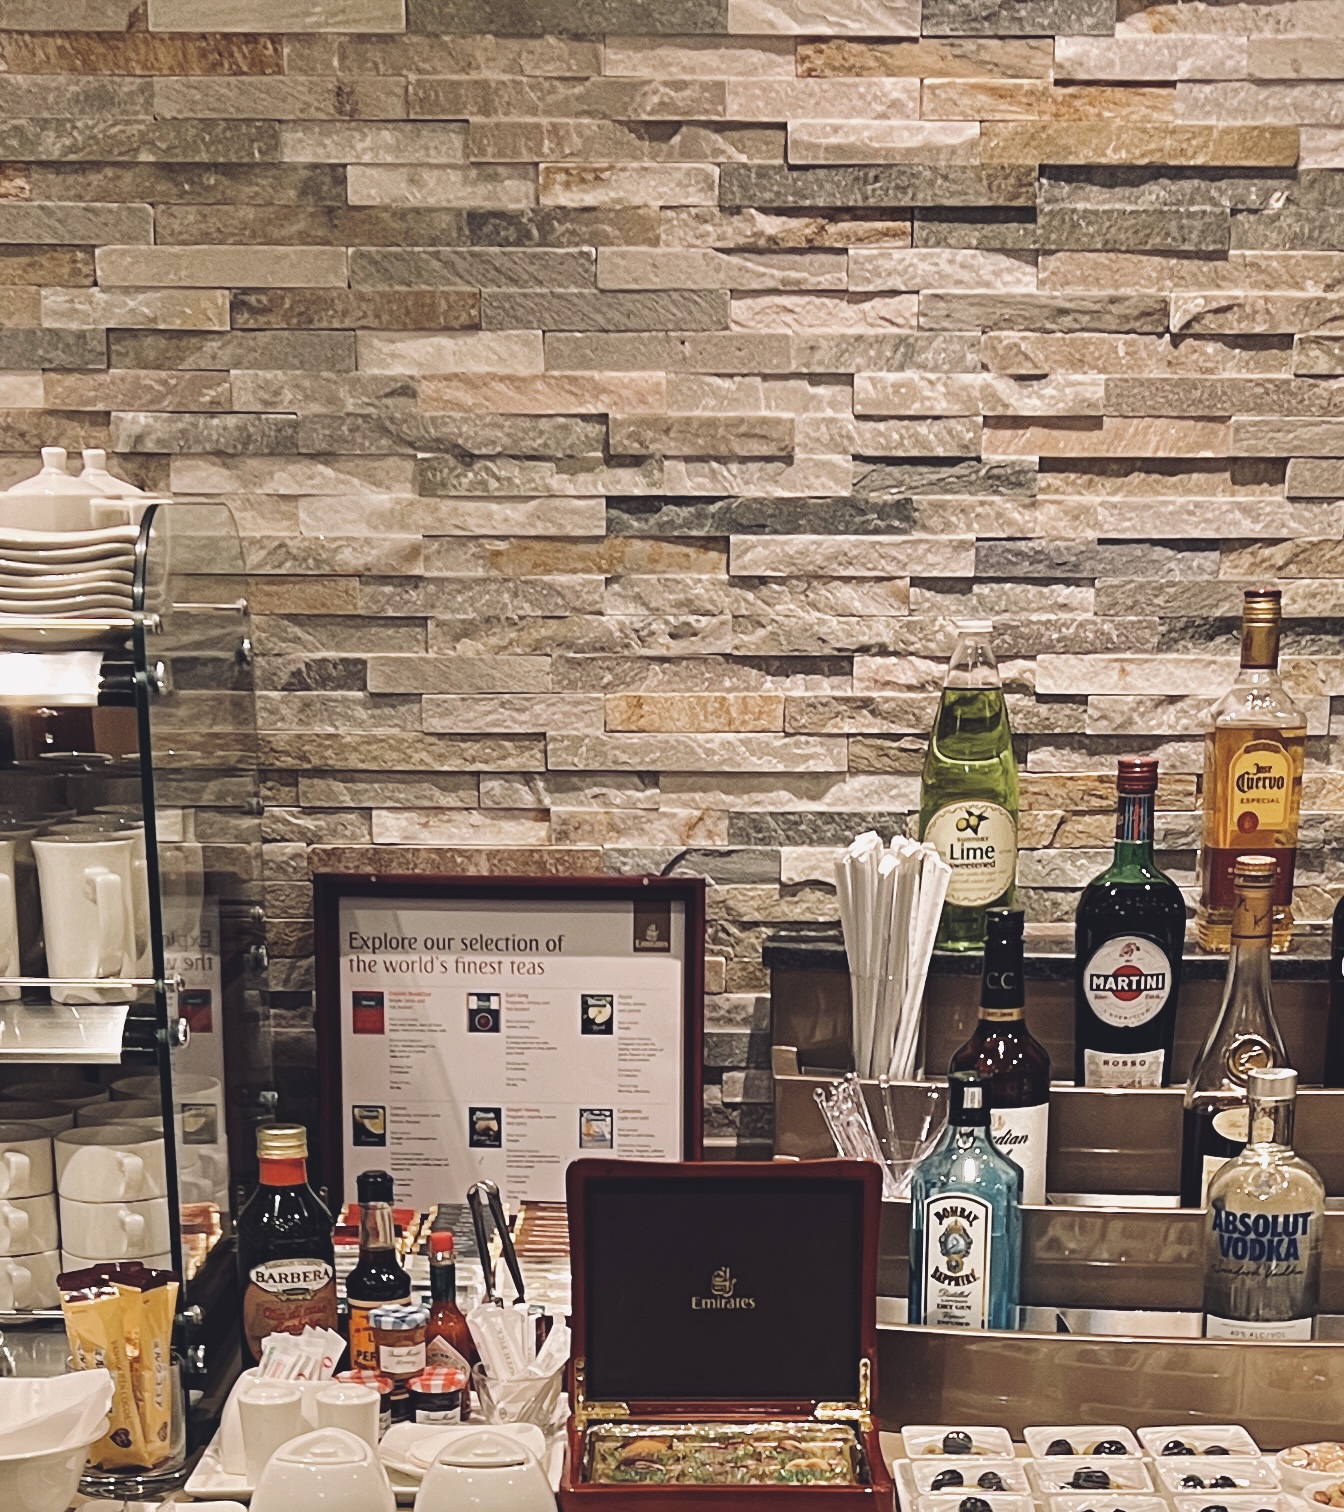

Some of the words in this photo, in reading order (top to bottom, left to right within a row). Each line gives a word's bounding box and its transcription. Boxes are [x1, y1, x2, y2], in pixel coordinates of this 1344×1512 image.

[1236, 770, 1285, 793] Cuervo
[1240, 797, 1280, 805] ESPECIAL
[949, 843, 996, 861] Lime
[349, 931, 418, 954] Explore
[424, 937, 456, 951] our
[461, 934, 539, 952] selection
[545, 935, 566, 952] of
[348, 955, 377, 974] the
[383, 956, 448, 975] world's
[455, 957, 504, 976] finest
[510, 960, 545, 976] teas
[1092, 974, 1164, 992] MARTINI
[1103, 1059, 1147, 1068] ROSSO
[934, 1205, 980, 1228] BOMBAY
[1211, 1211, 1312, 1238] ABSOLUT
[1218, 1235, 1300, 1262] VODKA
[256, 1267, 331, 1284] BARBERA
[691, 1296, 755, 1310] Emirates
